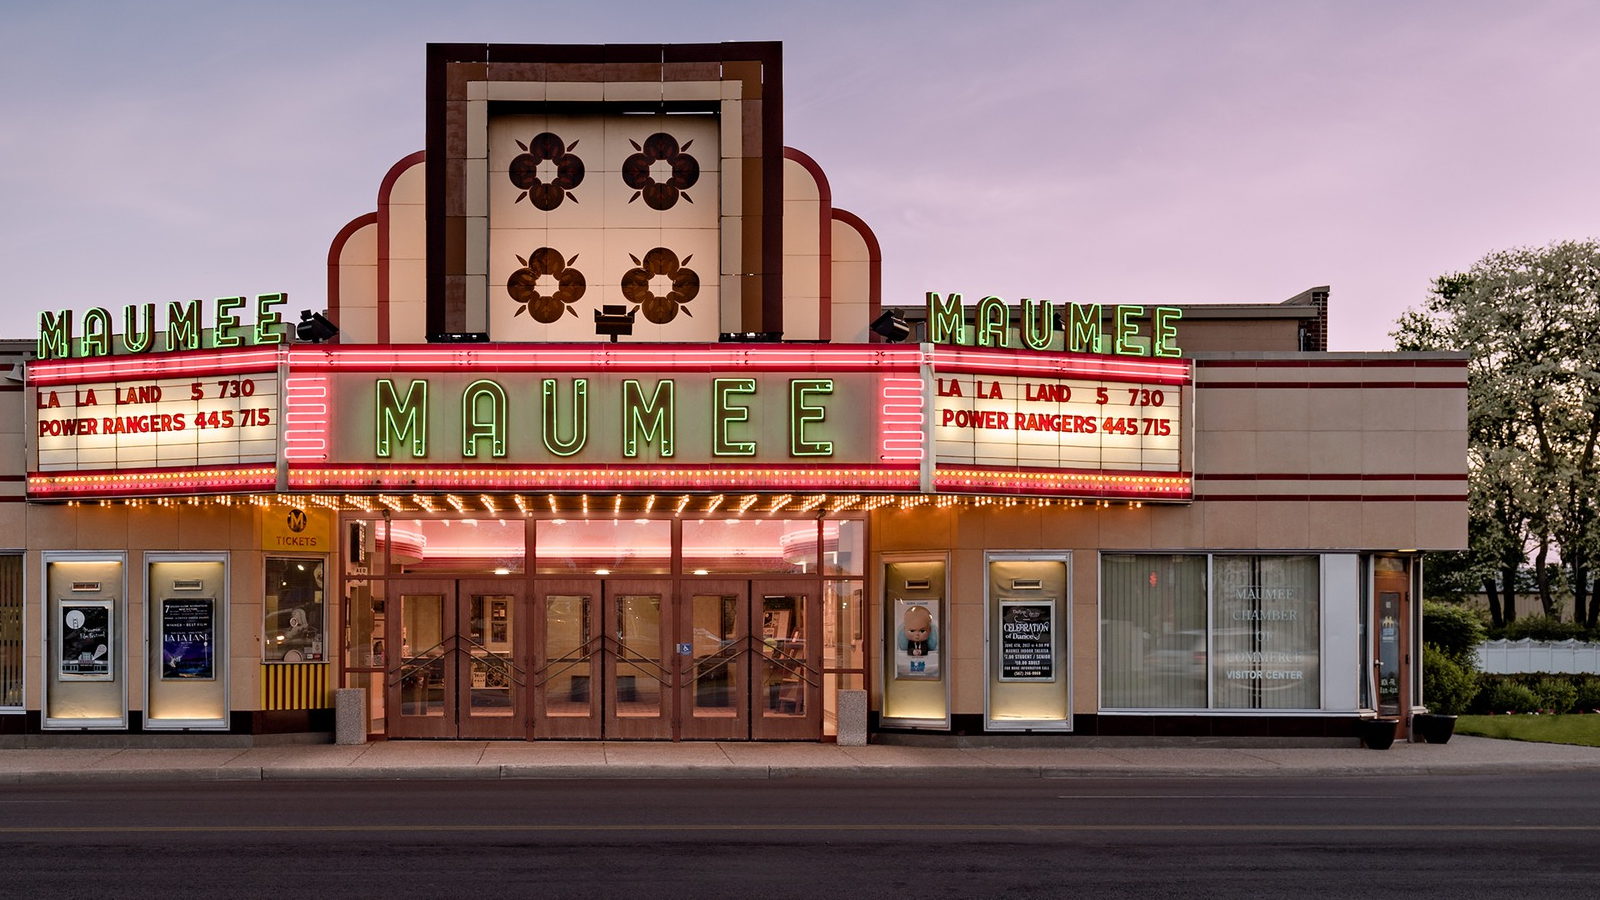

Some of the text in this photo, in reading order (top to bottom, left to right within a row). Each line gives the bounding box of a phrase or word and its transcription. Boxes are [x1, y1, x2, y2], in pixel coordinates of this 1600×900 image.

[37, 293, 289, 359] MAUMEE
[926, 292, 1183, 357] MAUMEE
[38, 379, 255, 409] LA LA LAND 5 730
[938, 378, 1164, 407] LA LA LAND 5 730
[40, 408, 270, 437] POWER RANGERS 445 715
[376, 378, 834, 457] MAUMEE
[942, 409, 1171, 436] POWER RANGERS 445 715
[291, 511, 304, 529] M
[276, 536, 317, 546] TICKETS
[1235, 588, 1294, 600] MAUMEE
[1232, 609, 1297, 620] CHAMBER
[1003, 621, 1050, 632] CELEBRATION
[1256, 630, 1273, 641] OF
[1226, 652, 1304, 662] COMMERCE
[1226, 670, 1303, 679] VISITOR CENTER
